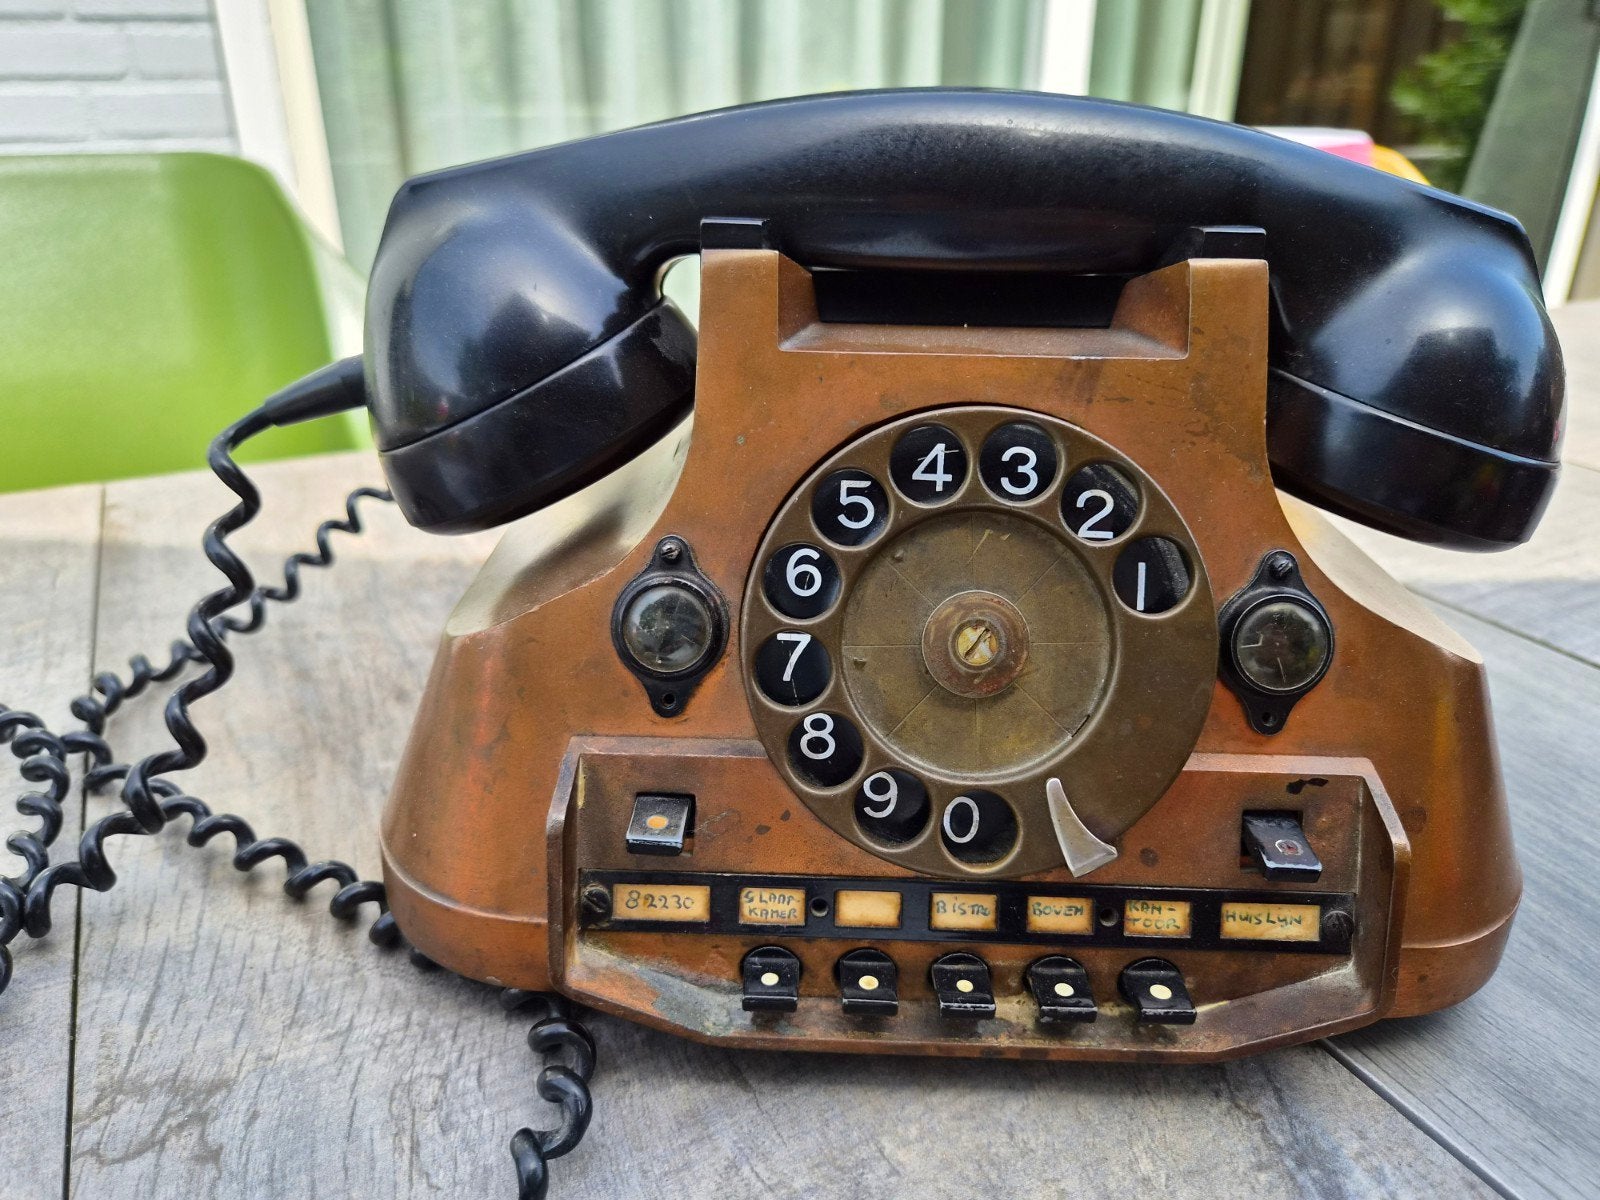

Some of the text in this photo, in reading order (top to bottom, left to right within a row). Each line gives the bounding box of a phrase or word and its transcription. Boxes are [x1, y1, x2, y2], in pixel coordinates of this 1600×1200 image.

[912, 443, 953, 492] 4
[1000, 446, 1038, 495] 3
[837, 480, 875, 529] 5
[1076, 489, 1115, 540] 2
[786, 548, 823, 597] 6
[1136, 562, 1147, 611] 1
[776, 633, 812, 682] 7
[800, 713, 836, 760] 8
[862, 772, 899, 818] 9
[625, 889, 695, 910] 82230
[748, 907, 798, 919] KAMER
